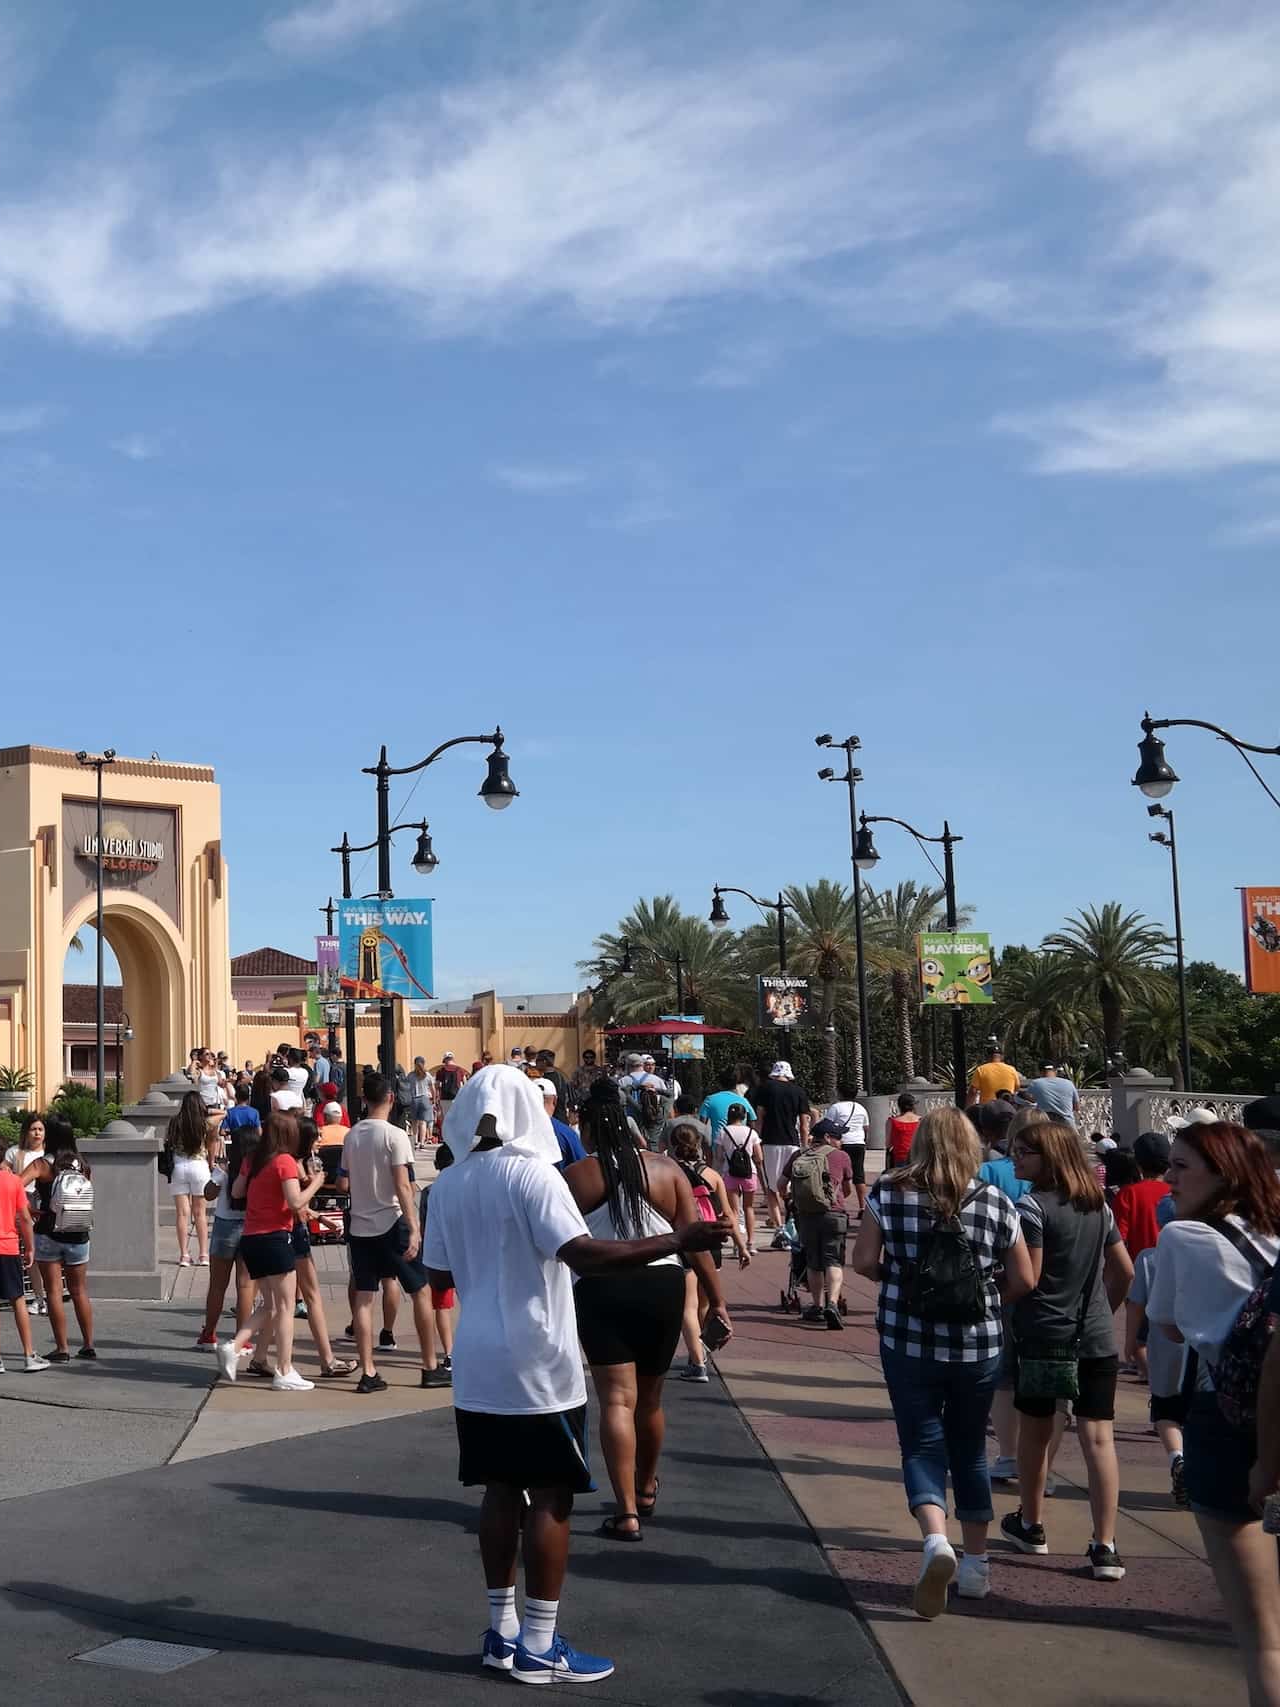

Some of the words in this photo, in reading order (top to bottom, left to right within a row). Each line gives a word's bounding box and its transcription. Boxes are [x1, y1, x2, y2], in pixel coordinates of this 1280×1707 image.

[84, 834, 138, 856] UNVERSAL
[343, 912, 383, 926] THIS
[385, 912, 429, 926] WAY.
[762, 979, 784, 988] THIS
[785, 979, 808, 988] WAY.
